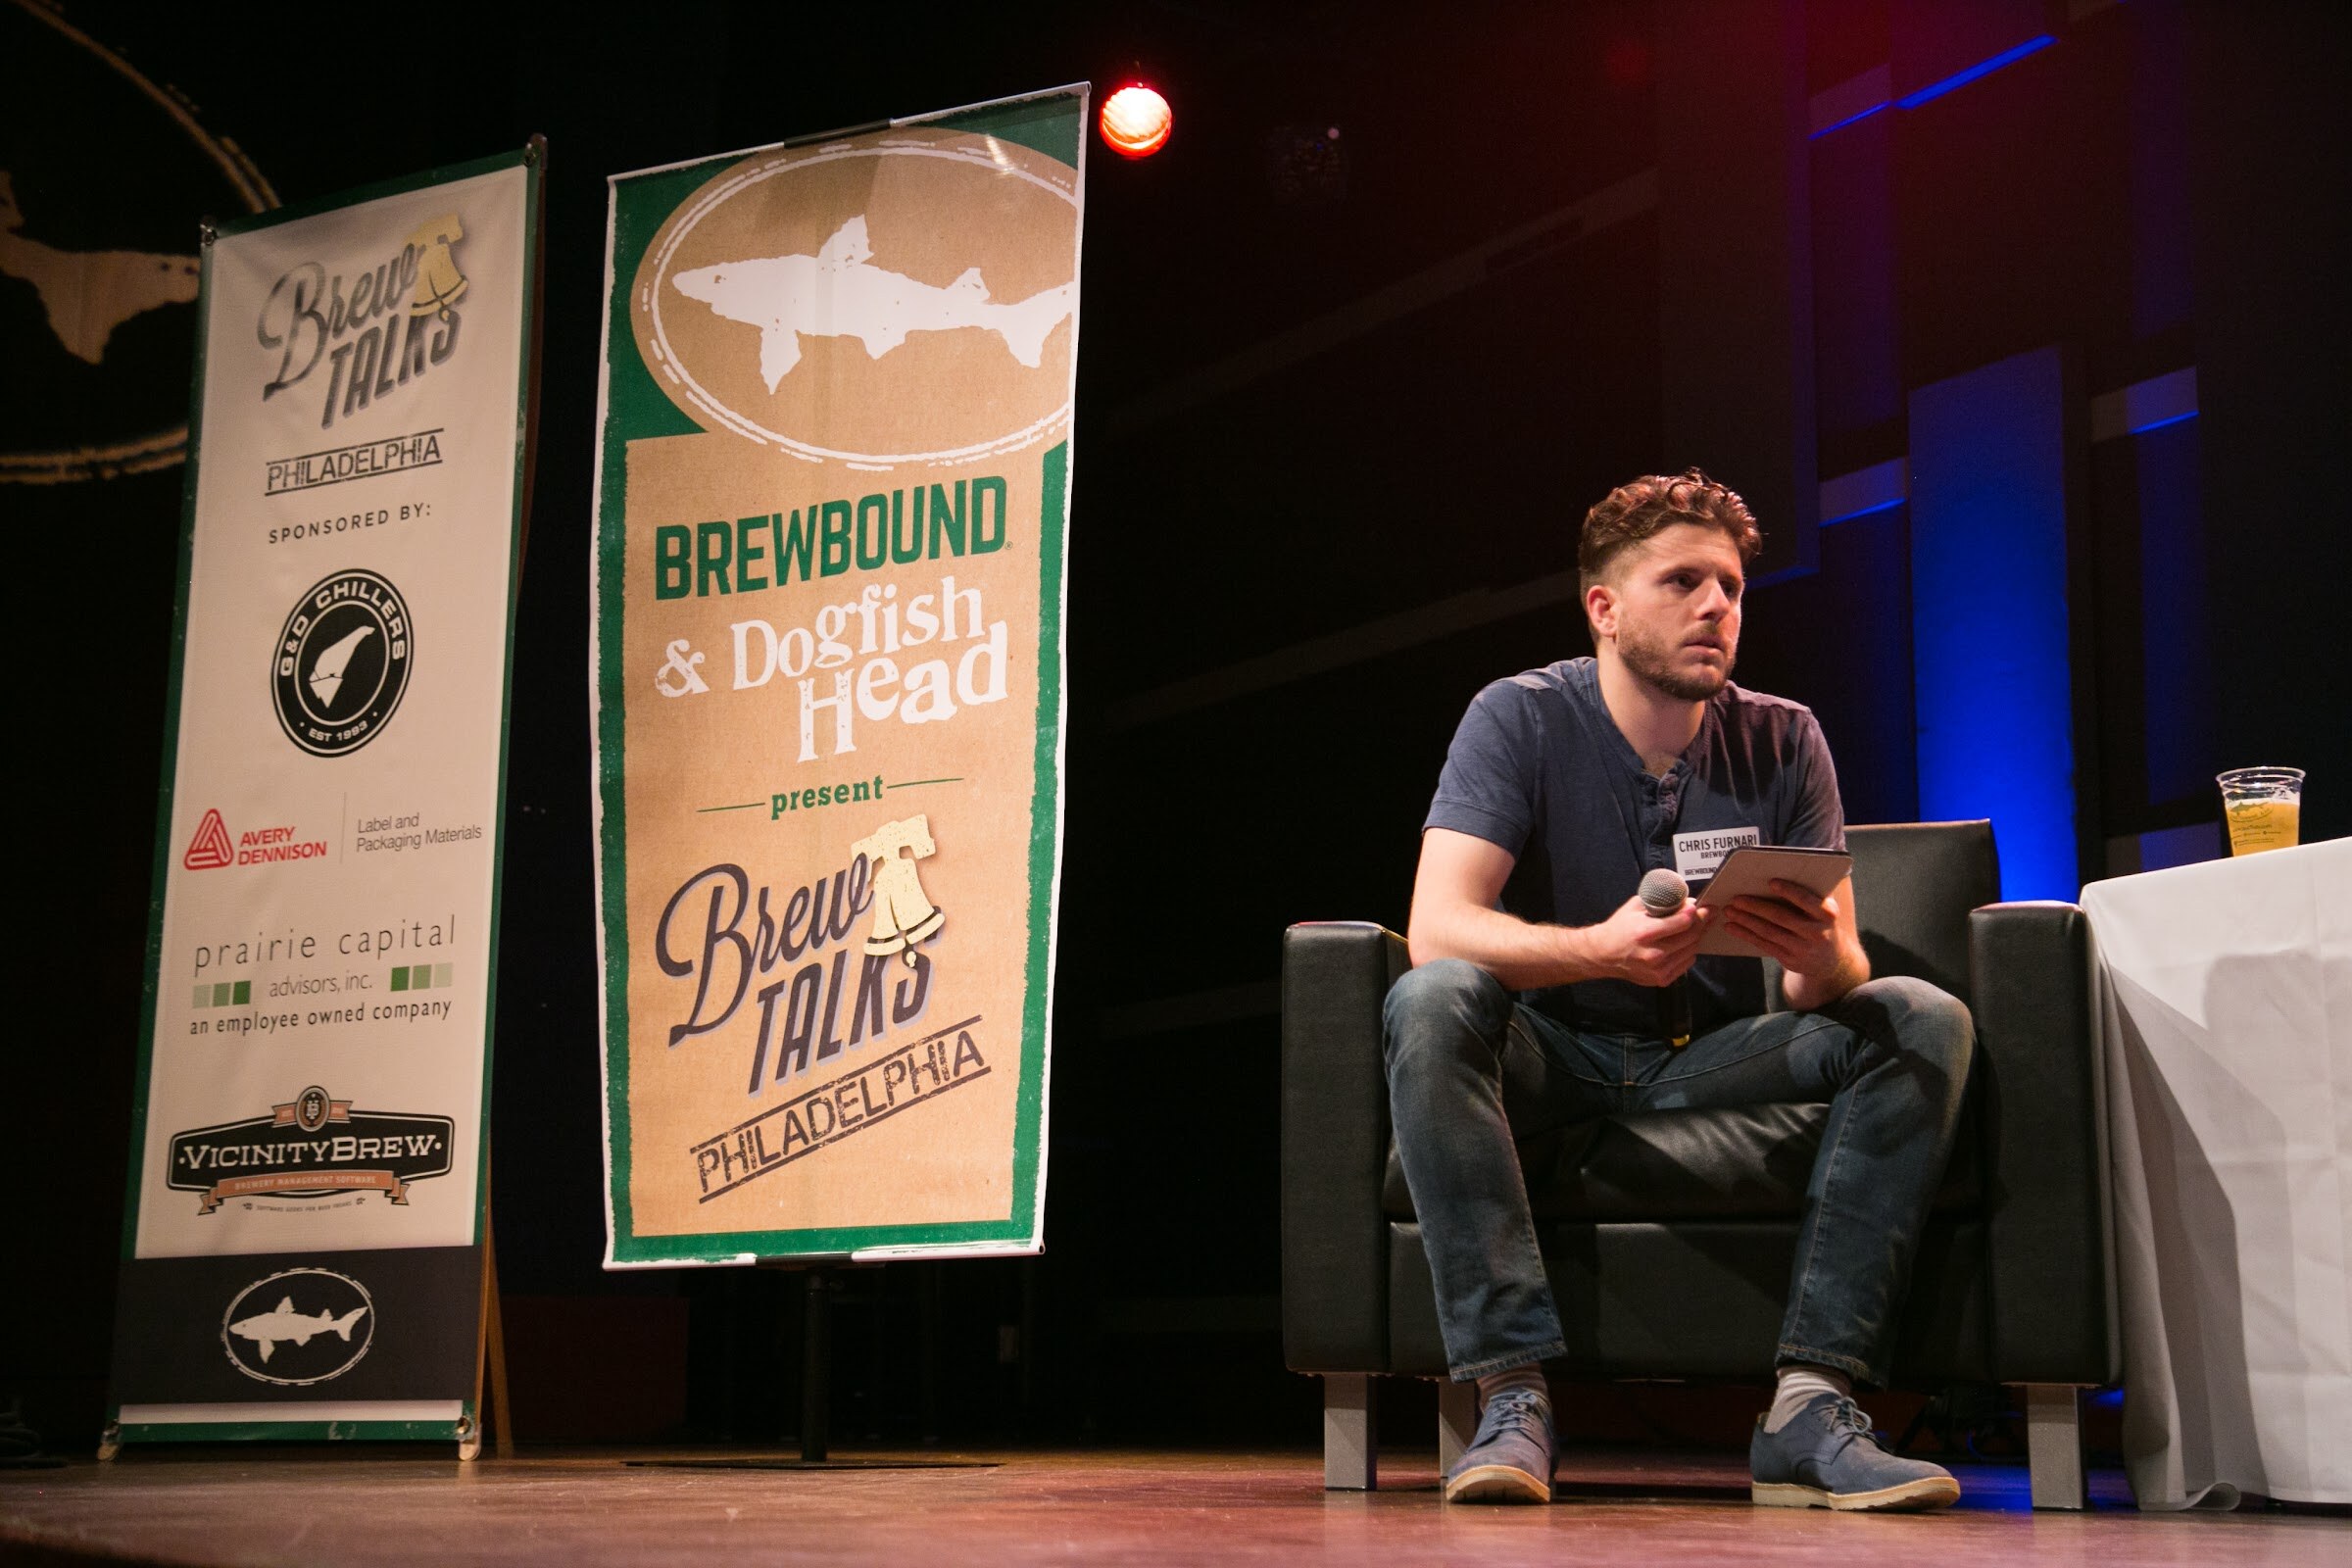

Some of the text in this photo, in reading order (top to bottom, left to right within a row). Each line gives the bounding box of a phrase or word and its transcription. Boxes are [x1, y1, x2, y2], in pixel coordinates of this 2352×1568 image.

[257, 242, 418, 403] Brew
[321, 312, 463, 430] TALKS
[267, 434, 441, 491] PHILADELPHIA
[269, 502, 431, 544] SPONSORED BY:
[280, 581, 406, 677] G&D CHILLERS
[655, 575, 986, 698] & Dogfish
[797, 619, 1009, 763] Head
[308, 727, 333, 743] EST
[770, 774, 884, 820] present
[239, 825, 297, 848] AVERY
[356, 823, 482, 853] Packaging Materials
[357, 812, 419, 834] Label and
[1679, 834, 1757, 853] CHRIS FURNARI
[237, 841, 327, 866] DENNISON
[194, 913, 455, 978] prairie capital
[655, 852, 877, 1049] Brew
[269, 969, 373, 998] advisors, inc.
[189, 1000, 453, 1037] an employee owned company
[748, 939, 936, 1098] TALKS
[697, 1029, 985, 1194] PHILADELPHIA
[277, 1175, 334, 1186] MANAGEMENT
[335, 1175, 377, 1184] SOFTWARE
